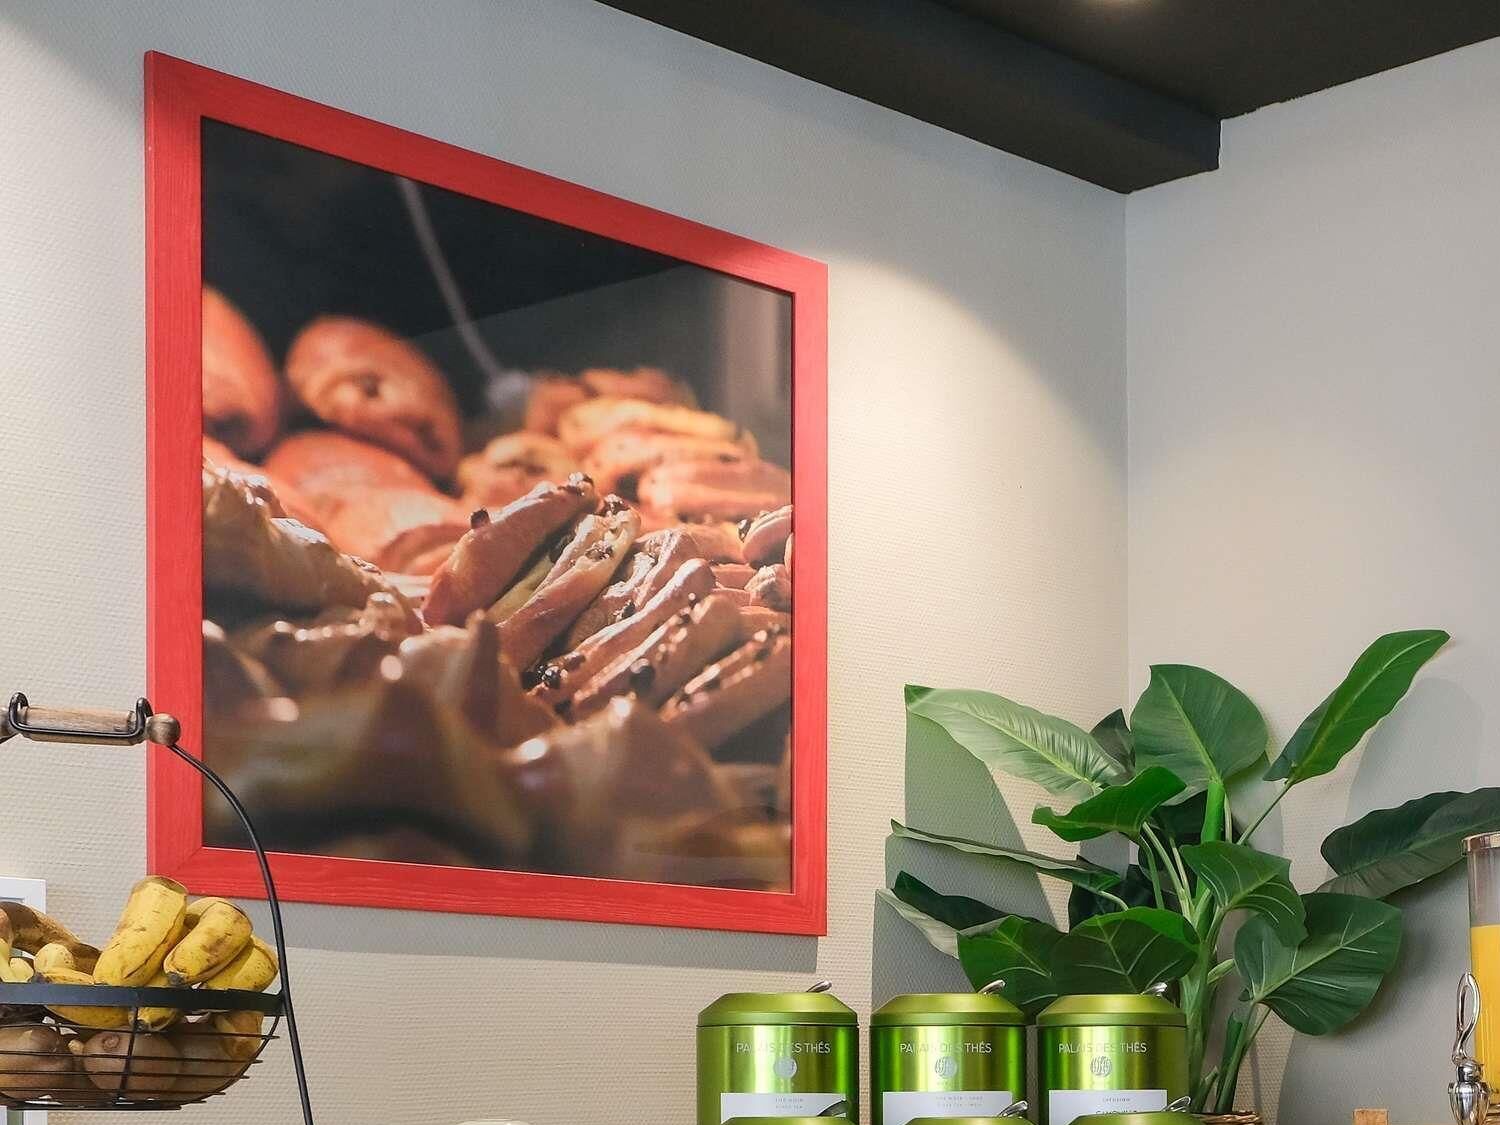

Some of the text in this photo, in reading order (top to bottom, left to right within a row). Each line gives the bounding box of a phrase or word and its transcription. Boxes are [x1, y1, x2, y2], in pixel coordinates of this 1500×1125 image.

[736, 1040, 831, 1054] PAIS ES THÉS
[900, 1042, 937, 1054] PAAI
[964, 1040, 992, 1054] THÉS
